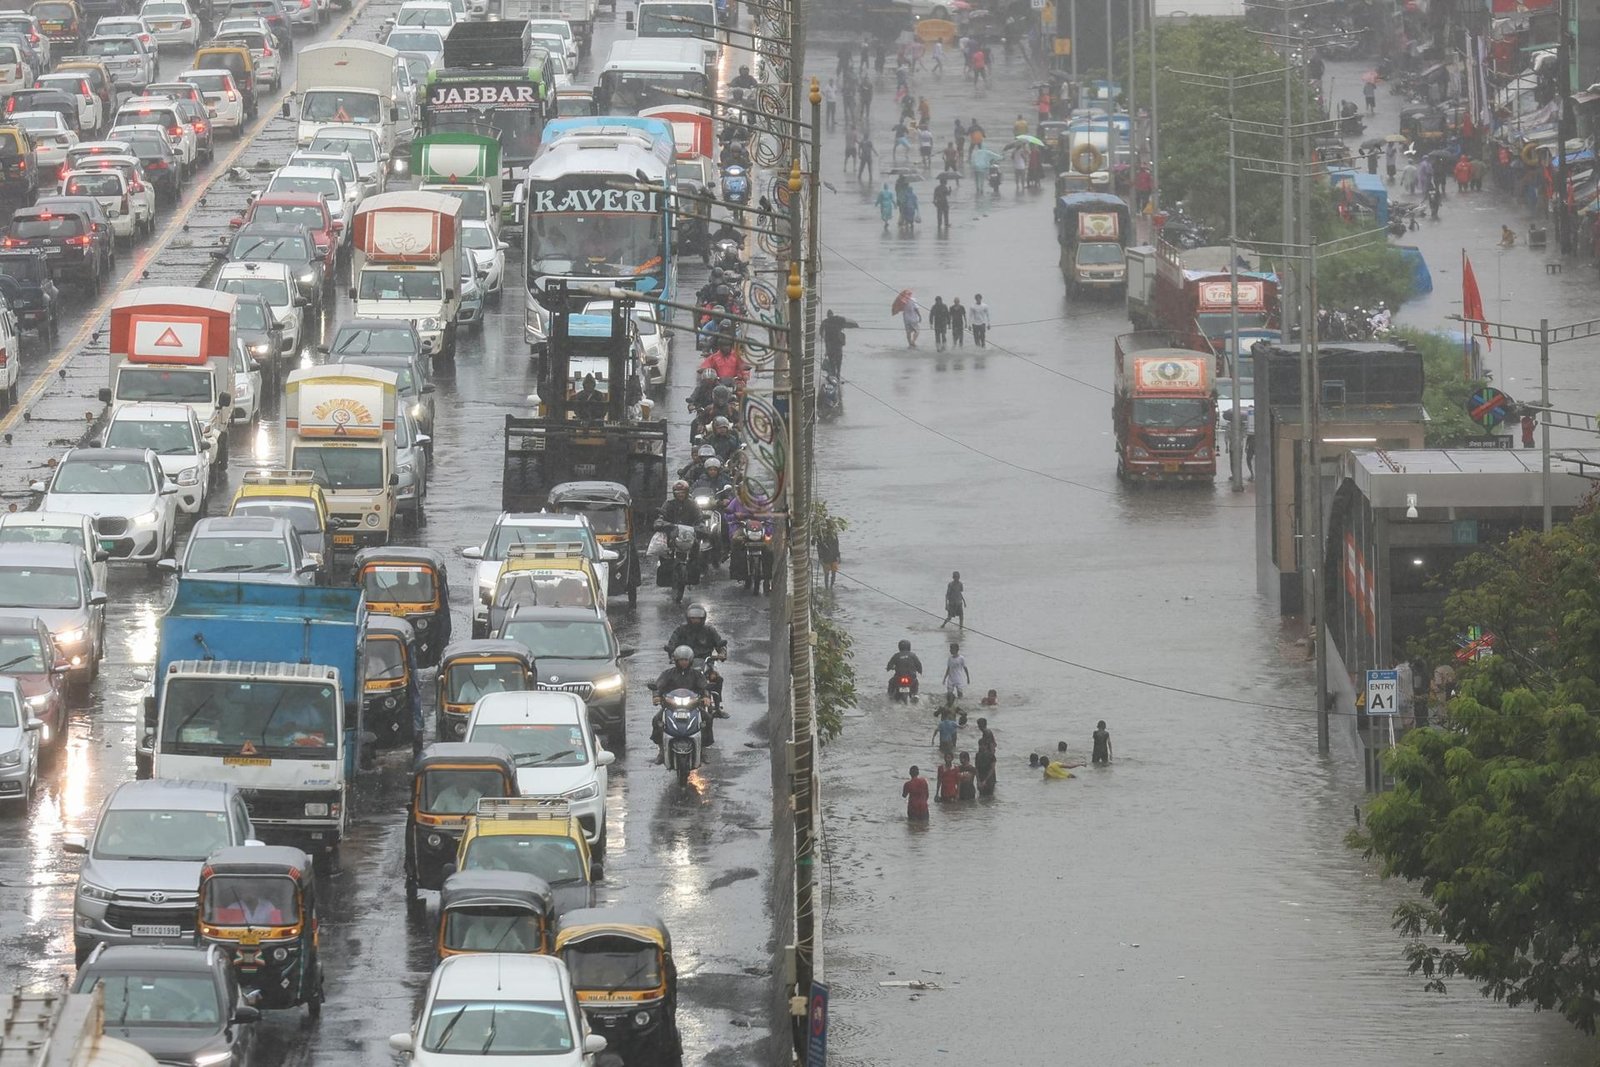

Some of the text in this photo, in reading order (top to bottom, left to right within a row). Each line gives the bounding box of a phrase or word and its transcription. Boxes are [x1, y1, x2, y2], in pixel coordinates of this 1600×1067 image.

[431, 86, 536, 105] JABBAR
[534, 189, 658, 213] KAVERI
[1371, 693, 1393, 709] A1
